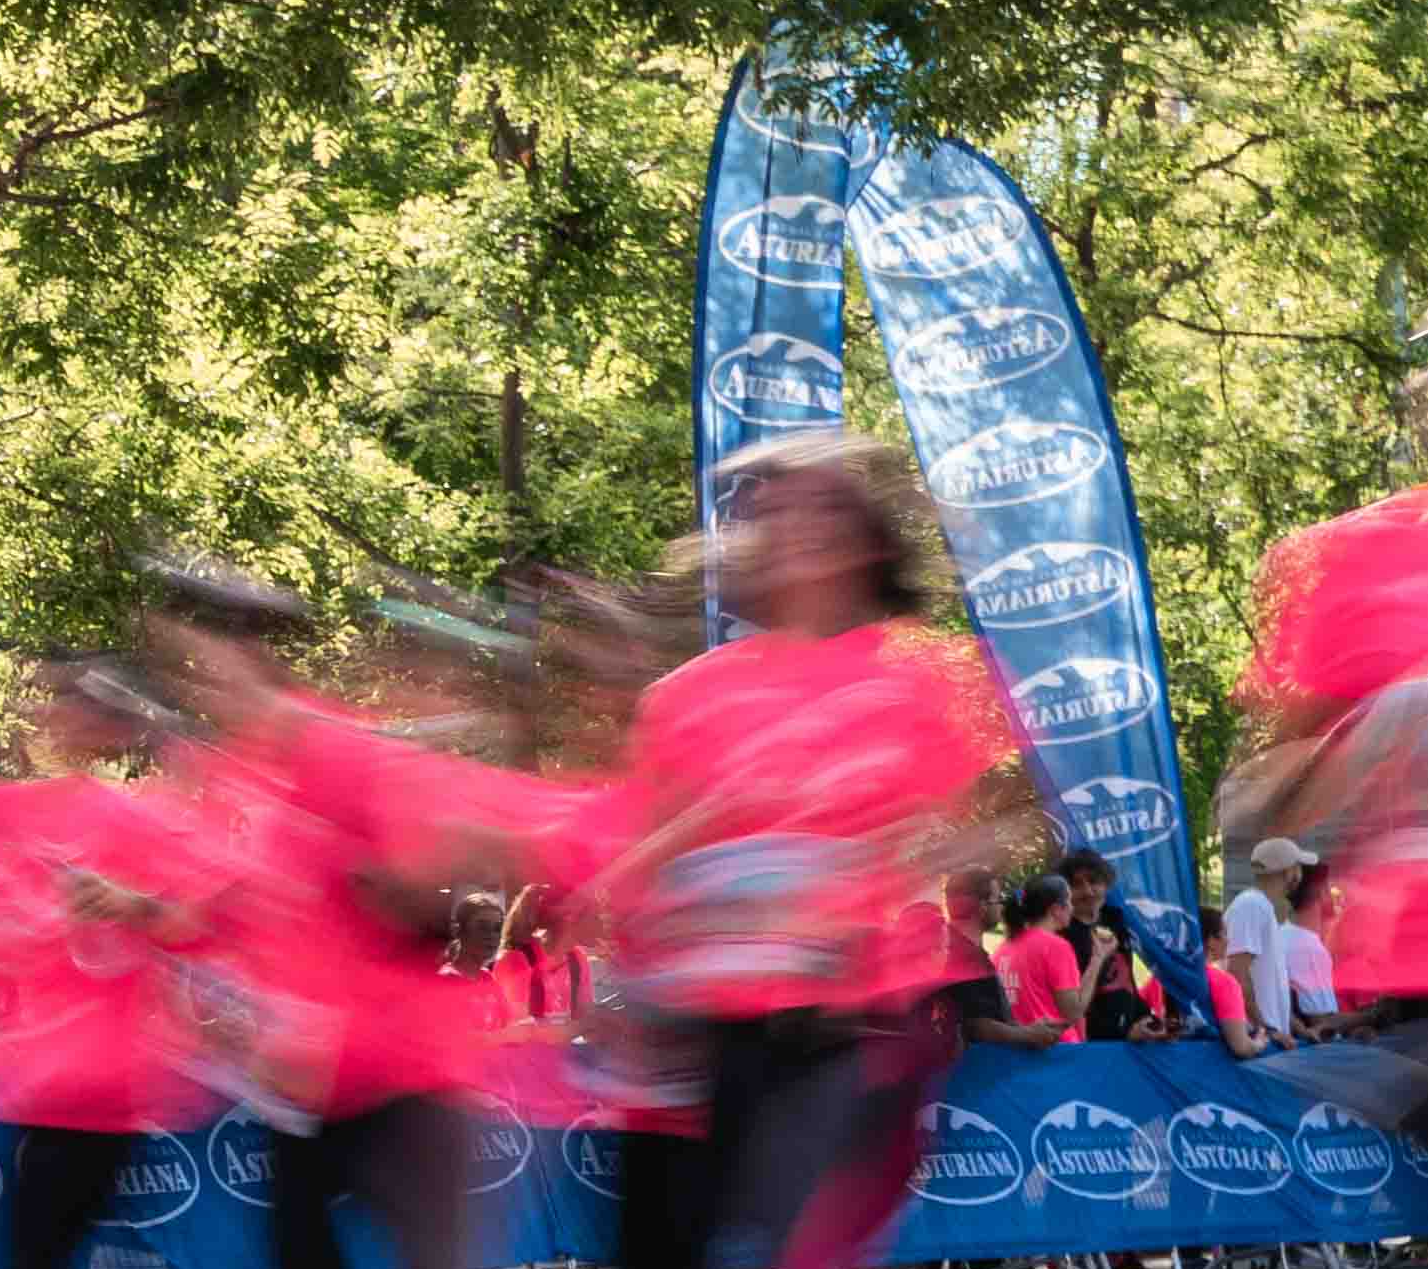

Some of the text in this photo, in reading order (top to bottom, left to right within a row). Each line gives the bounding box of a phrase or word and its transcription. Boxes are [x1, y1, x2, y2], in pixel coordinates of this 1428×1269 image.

[917, 1149, 1017, 1179] STURIANA
[1045, 1137, 1155, 1176] ASTURIANA
[1301, 1137, 1388, 1174] ASTURIANA
